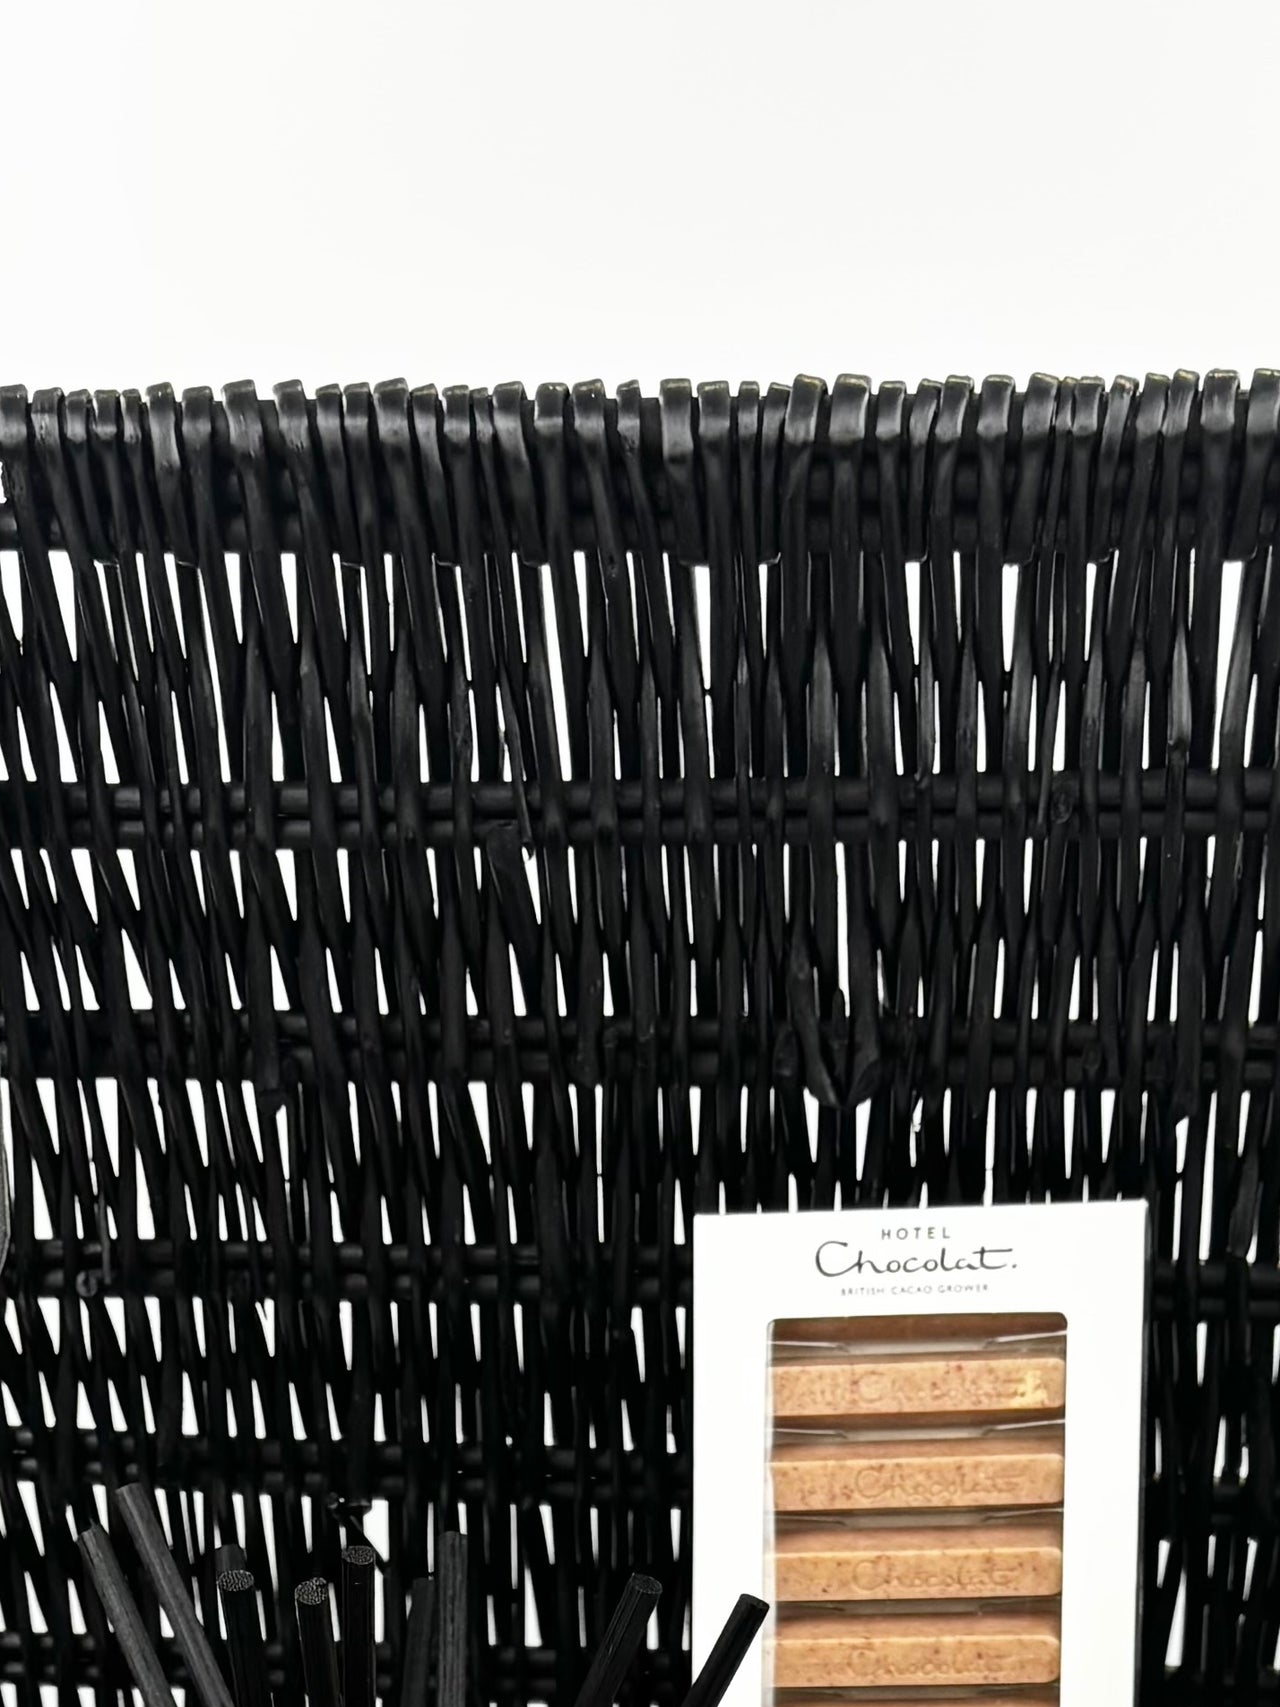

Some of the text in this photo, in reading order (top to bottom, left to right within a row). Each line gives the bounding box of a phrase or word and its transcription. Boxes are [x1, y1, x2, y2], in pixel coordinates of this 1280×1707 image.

[881, 1226, 951, 1241] HOTEL
[841, 1287, 885, 1297] BRITISH
[938, 1284, 988, 1294] GROWER
